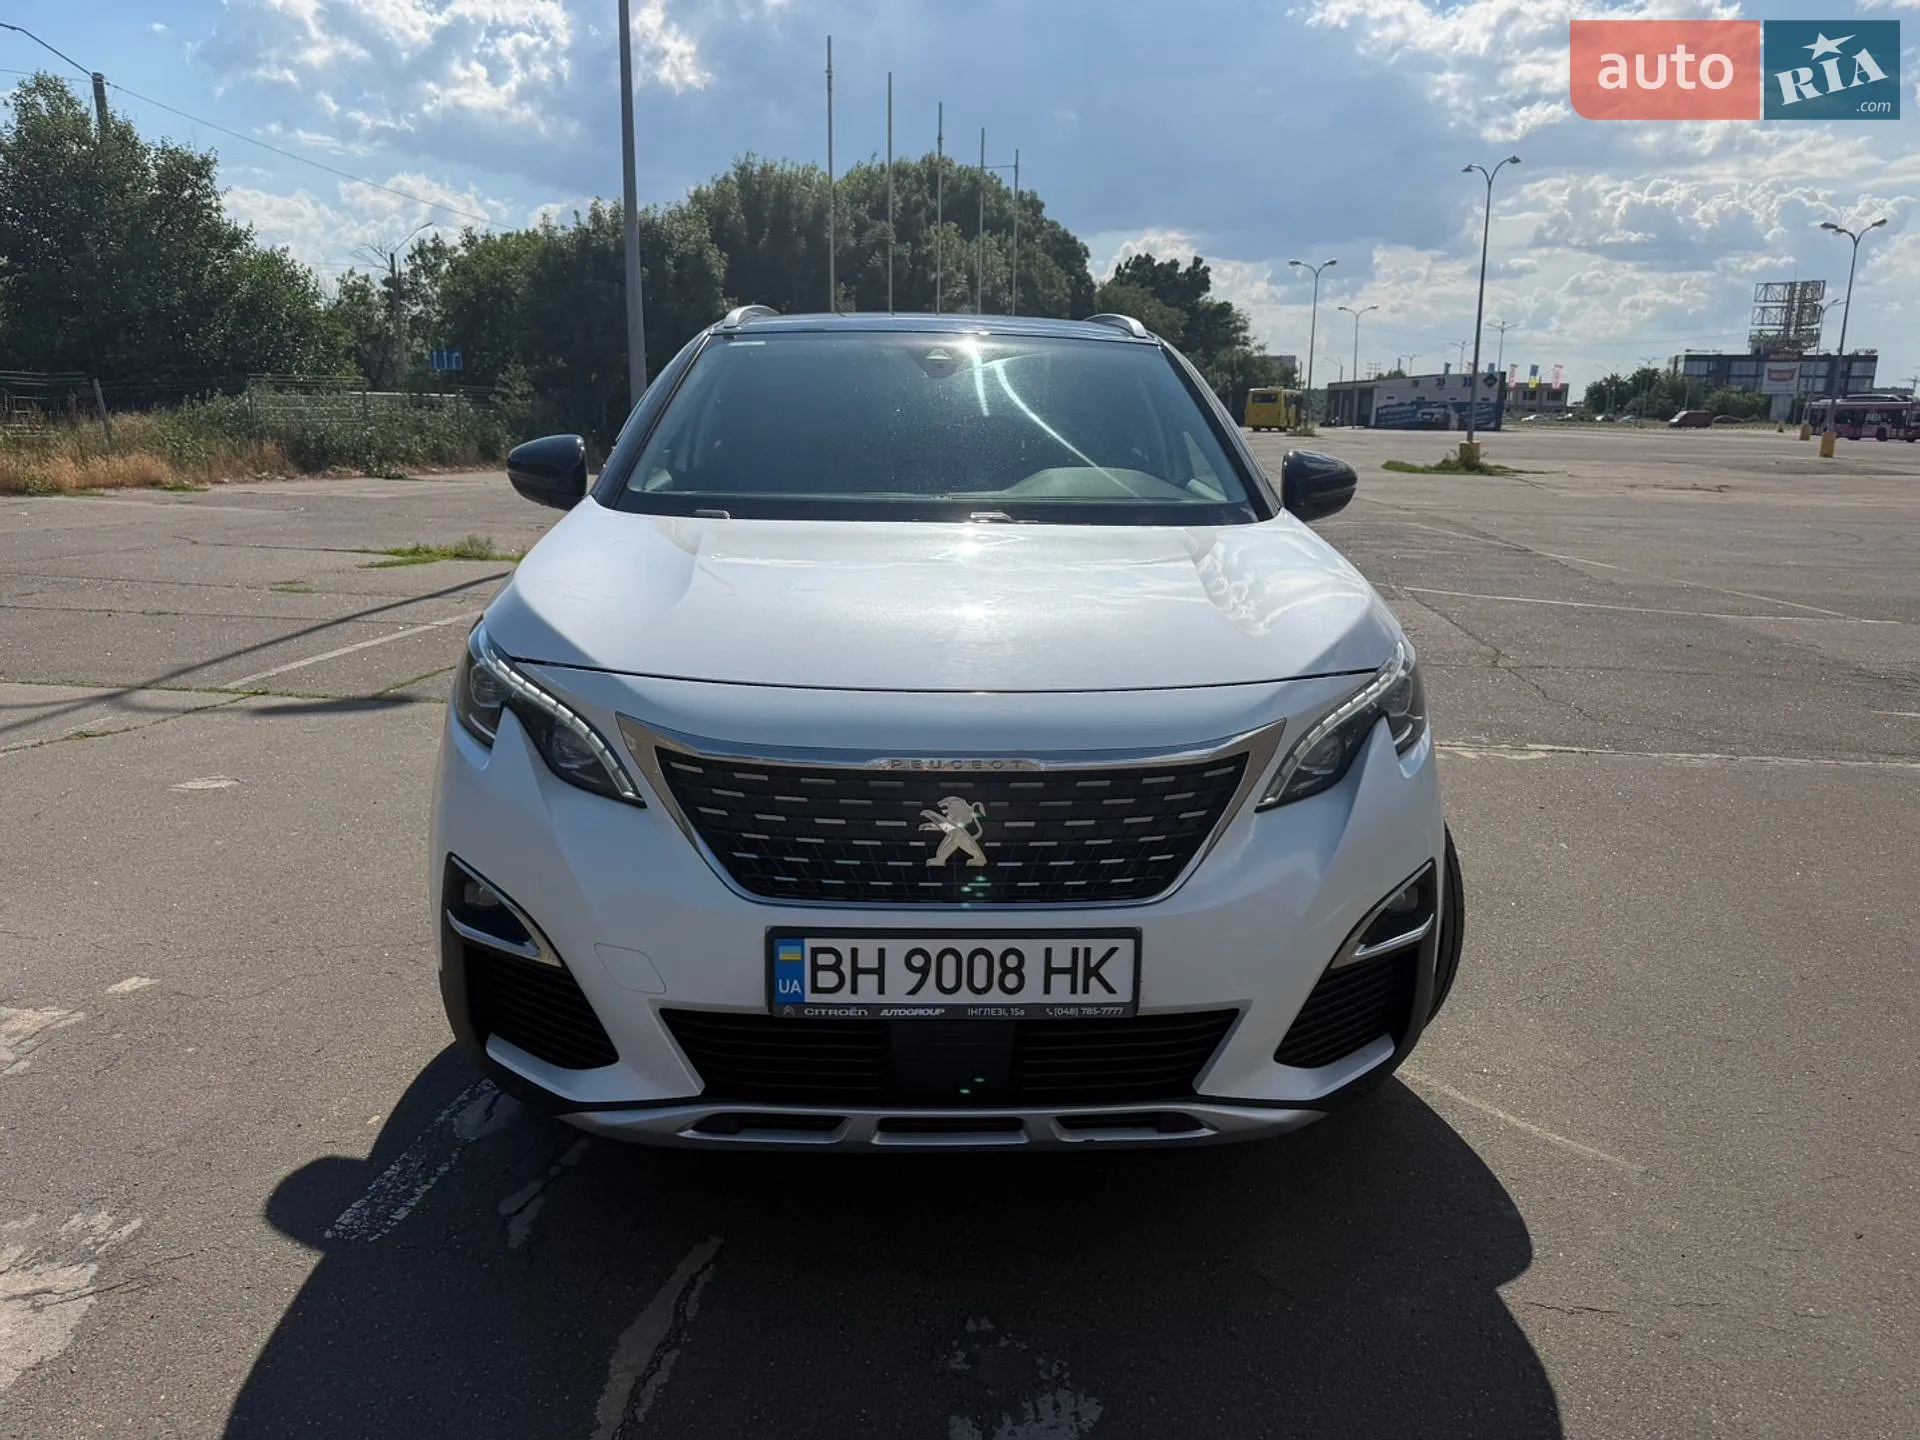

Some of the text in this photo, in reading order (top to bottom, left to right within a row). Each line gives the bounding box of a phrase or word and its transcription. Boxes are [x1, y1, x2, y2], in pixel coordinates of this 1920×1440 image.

[890, 758, 1024, 770] PEUGEOT
[809, 946, 1120, 996] BH 9008 HK
[778, 979, 802, 994] UA
[880, 1007, 945, 1016] AUTOGROUP
